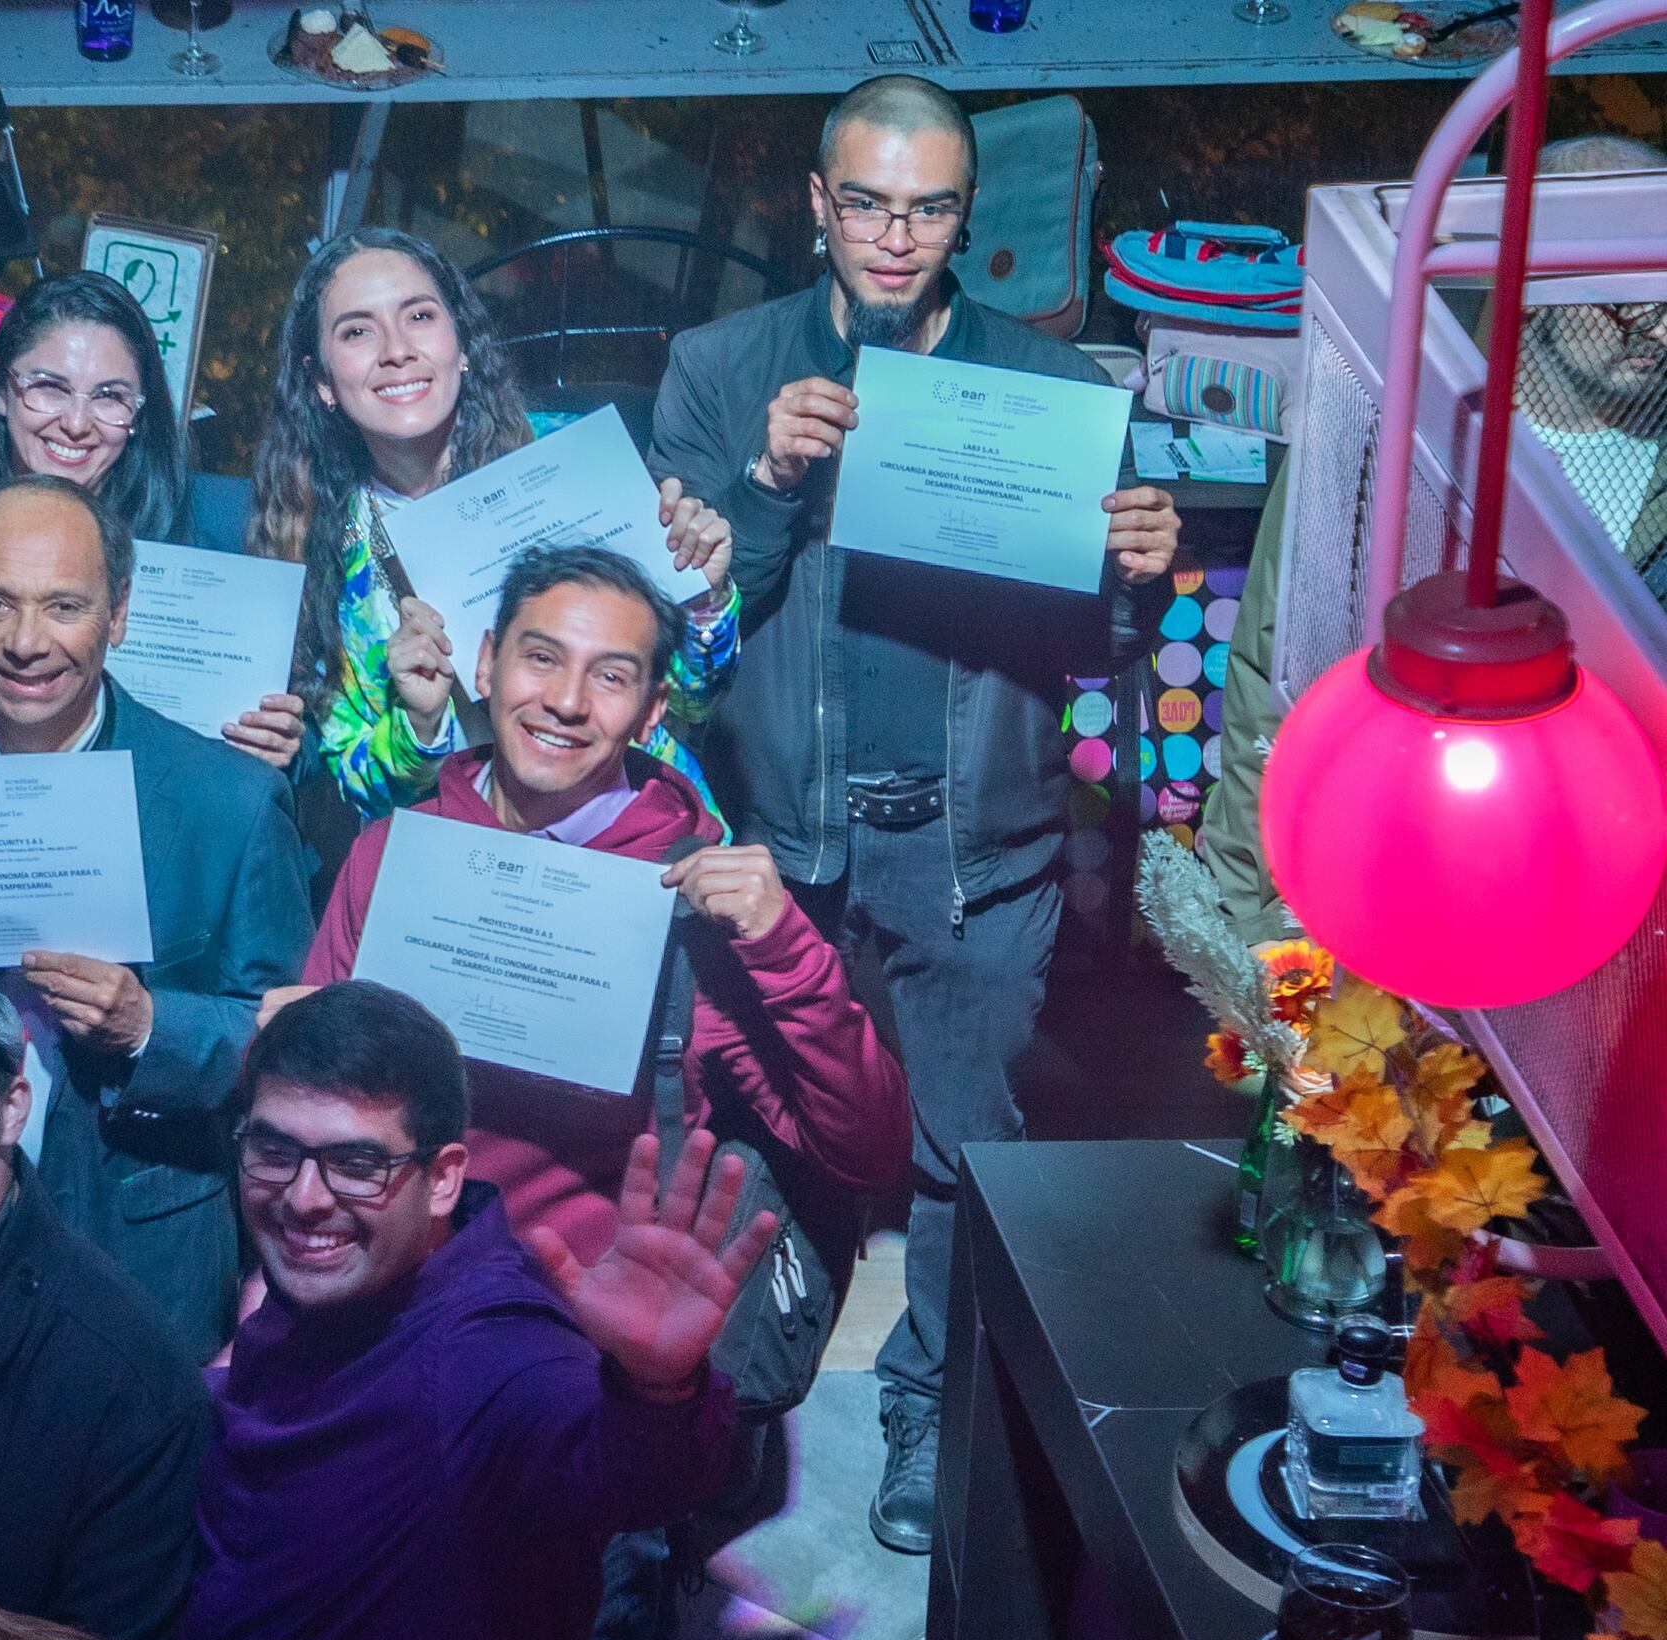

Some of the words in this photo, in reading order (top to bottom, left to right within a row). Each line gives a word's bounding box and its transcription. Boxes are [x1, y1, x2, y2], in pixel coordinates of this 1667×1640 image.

[961, 390, 986, 401] ean
[880, 460, 928, 475] CIRCULARIZA
[928, 467, 962, 481] BOGOTÁ:
[963, 473, 1006, 489] ECONOMÍA
[1006, 482, 1042, 495] CIRCULAR
[1043, 488, 1064, 499] PARA
[1065, 492, 1073, 500] EL
[140, 565, 165, 574] ean
[461, 582, 506, 609] CIRCULARIZ
[129, 611, 165, 622] AMALEON
[1161, 702, 1197, 722] LOVE
[32, 870, 69, 879] CIRCULAR
[71, 868, 93, 877] PARA
[95, 868, 102, 876] EL
[497, 860, 525, 875] ean
[404, 935, 456, 954] CIRCULARIZA
[456, 945, 493, 962] BOGOTÁ:
[494, 954, 539, 973] ECONOMÍA
[539, 966, 579, 982] CIRCULAR
[579, 975, 603, 988] PARA
[603, 980, 612, 990] EL
